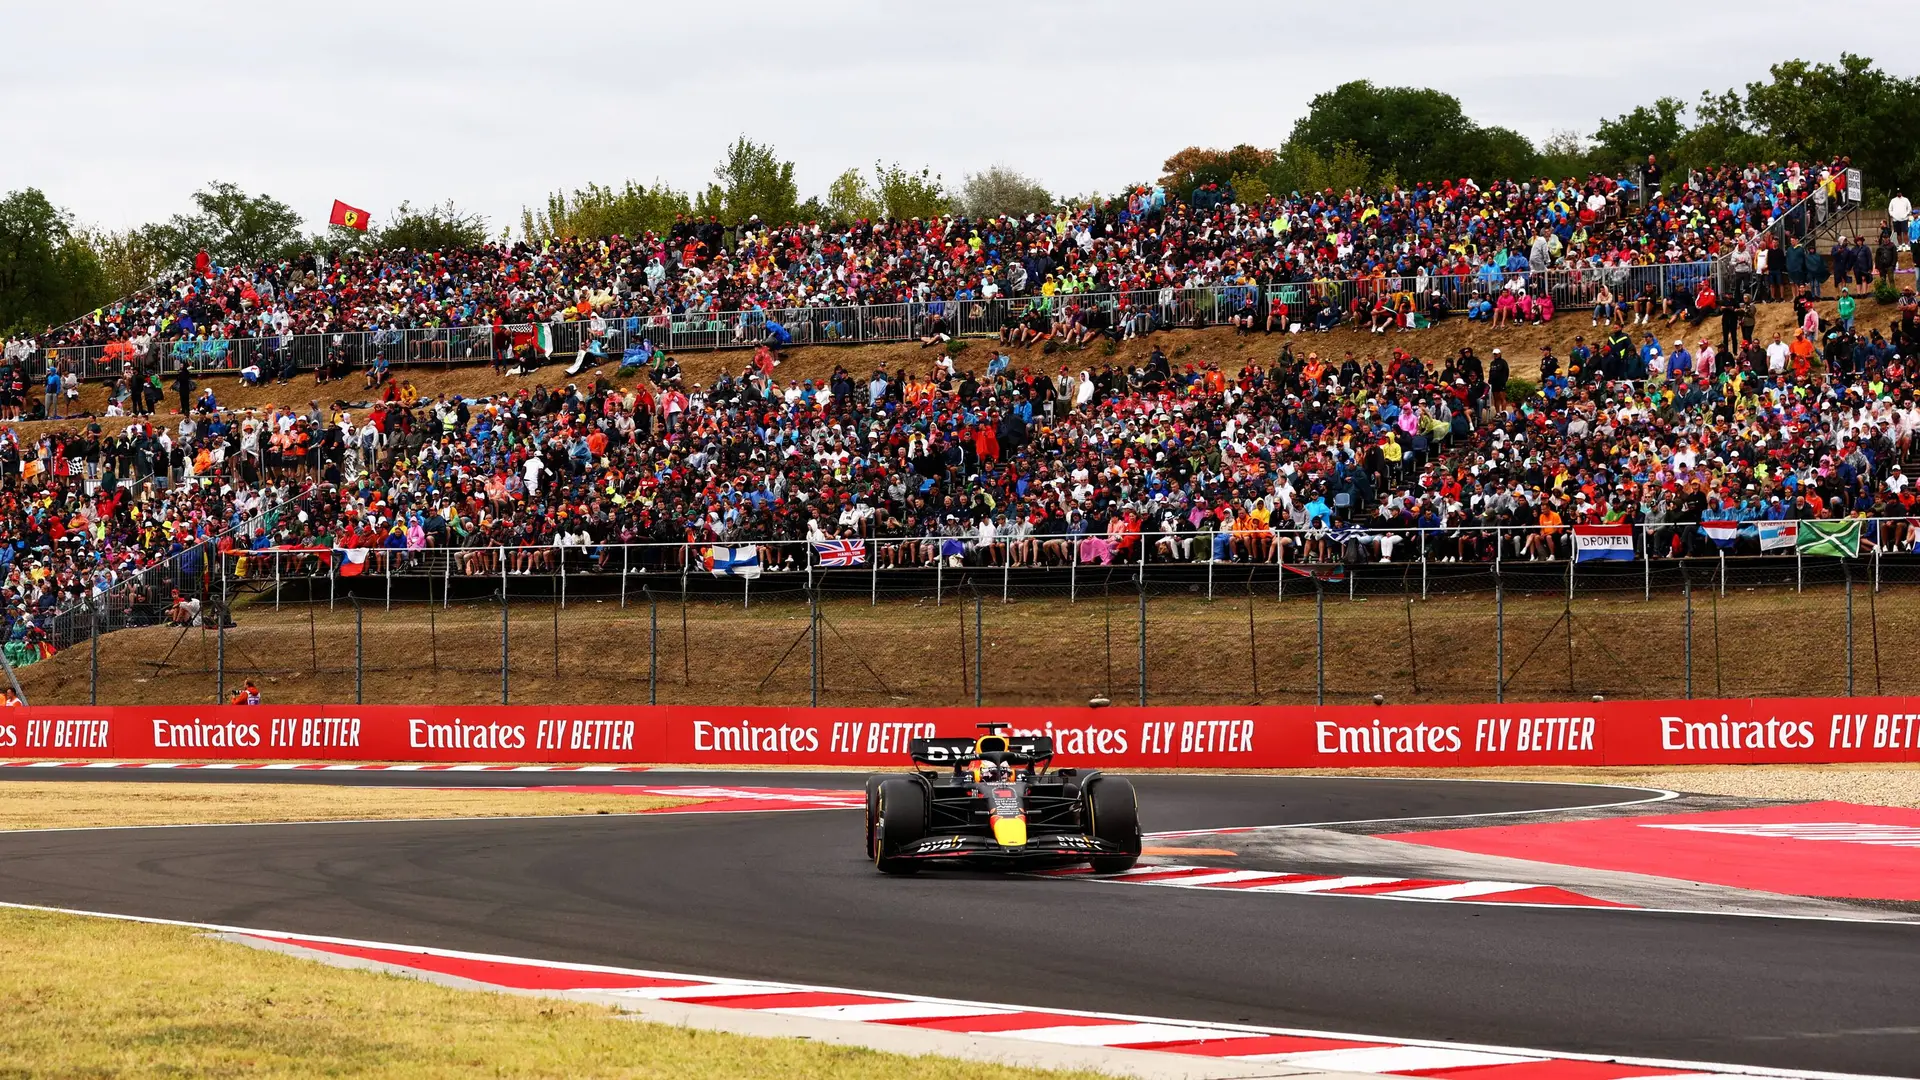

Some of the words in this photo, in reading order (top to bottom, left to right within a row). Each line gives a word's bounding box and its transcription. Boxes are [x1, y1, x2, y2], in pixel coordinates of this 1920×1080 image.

[1582, 536, 1629, 546] DRONTEN
[26, 720, 52, 747] FLY
[54, 720, 109, 748] BETTER
[153, 720, 261, 748] Emirates
[270, 719, 298, 747] FLY
[301, 718, 361, 748] BETTER
[409, 717, 526, 749] Emirates
[537, 719, 567, 749] FLY
[570, 720, 635, 750] BETTER
[693, 720, 819, 752] Emirates
[830, 722, 864, 753] FLY
[1140, 722, 1176, 753] FLY
[1181, 720, 1254, 753] BETTER
[1316, 719, 1461, 754] Emirates
[1475, 718, 1512, 752] FLY
[1516, 717, 1596, 751] BETTER
[1660, 713, 1815, 750] Emirates
[1829, 714, 1868, 749] FLY
